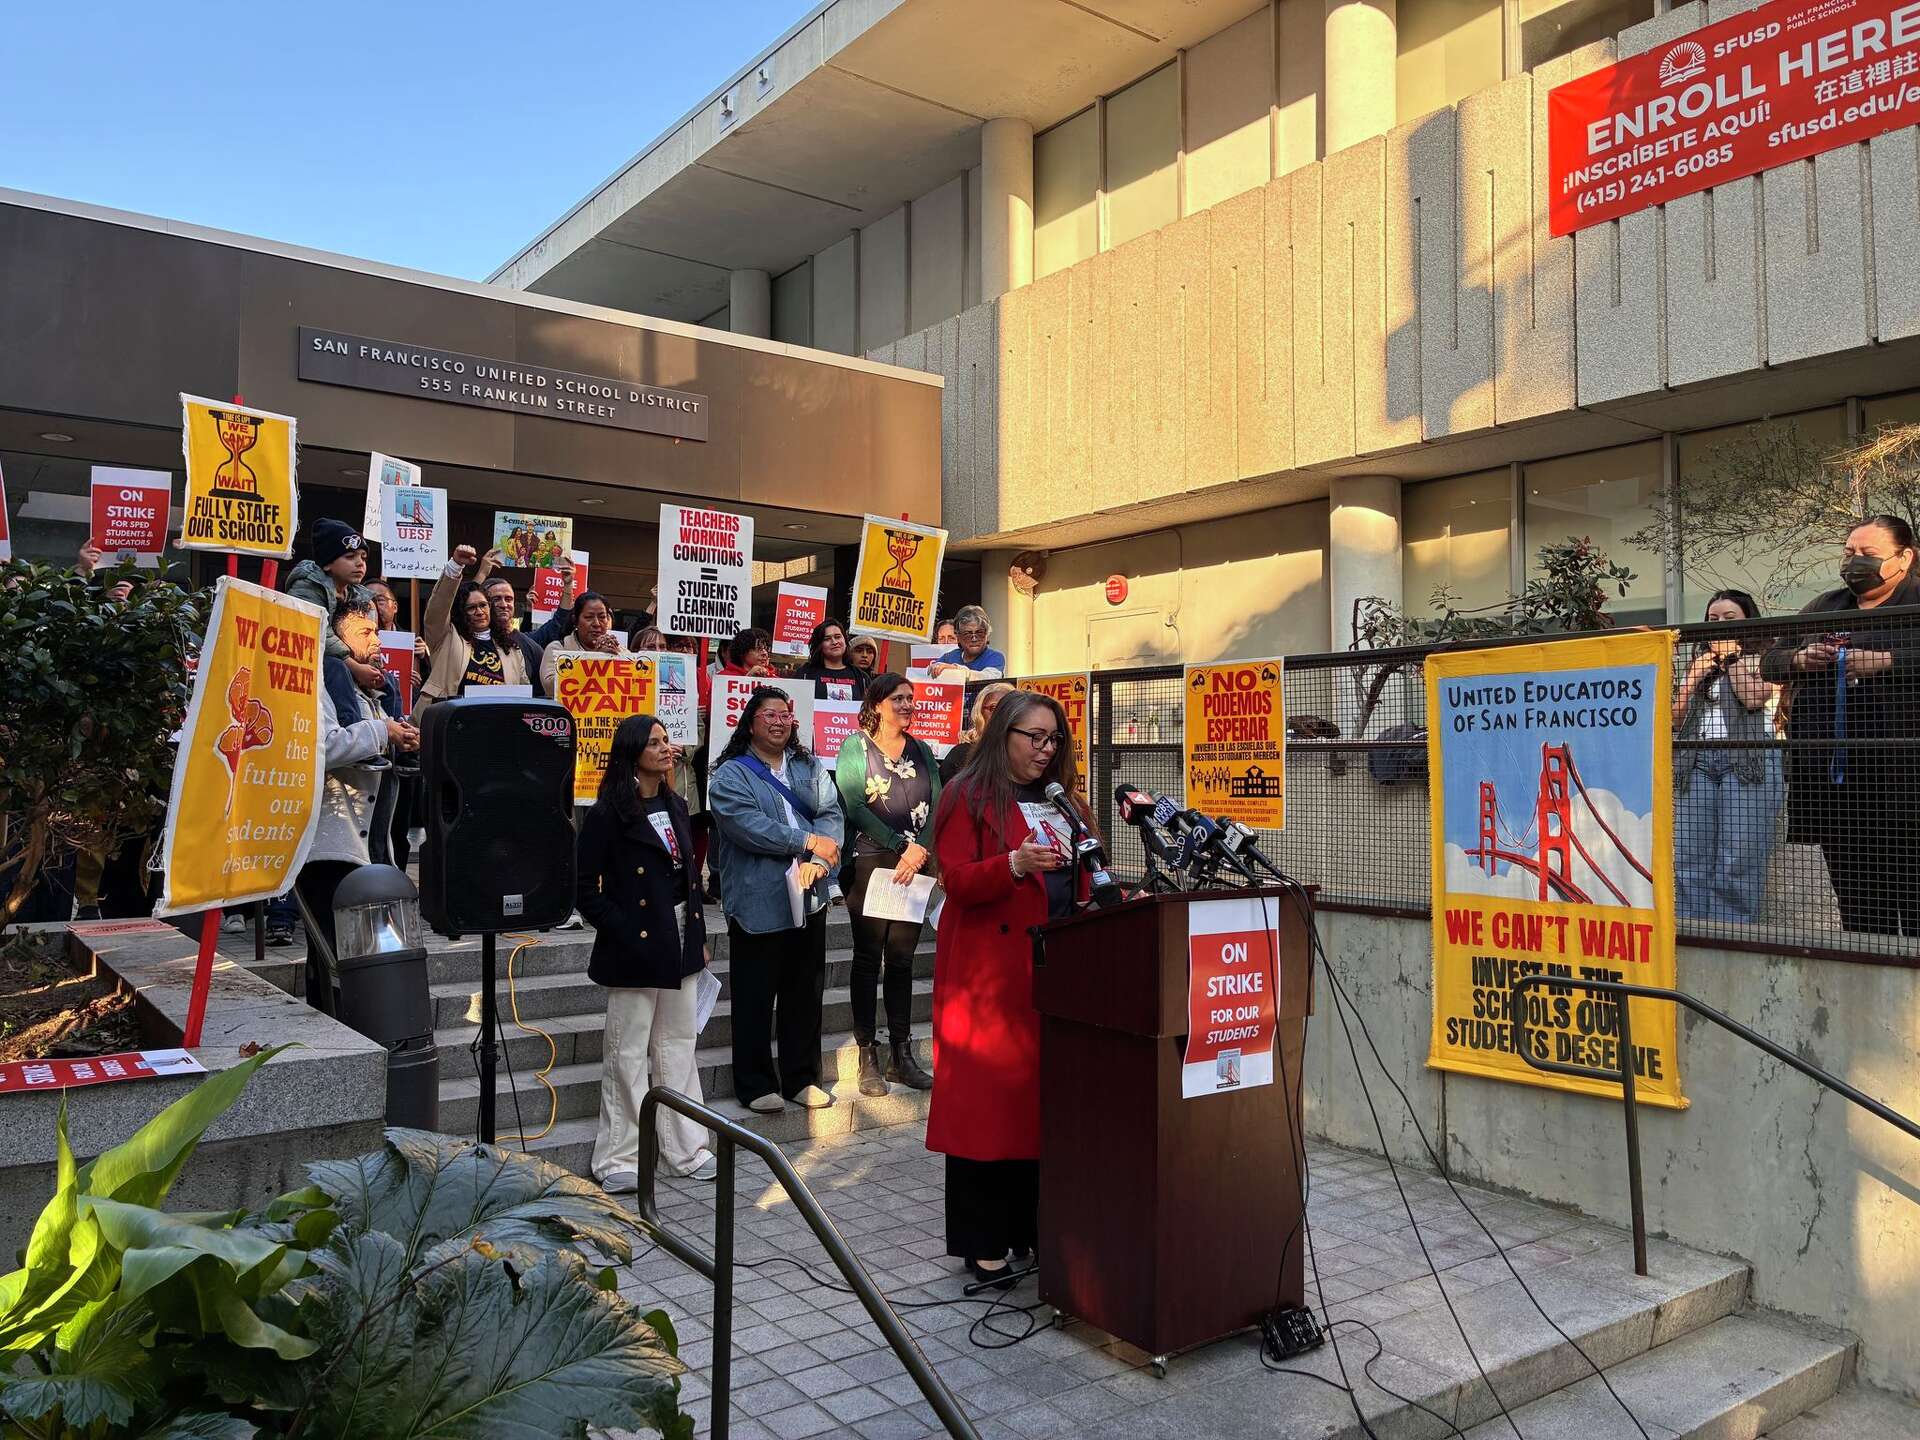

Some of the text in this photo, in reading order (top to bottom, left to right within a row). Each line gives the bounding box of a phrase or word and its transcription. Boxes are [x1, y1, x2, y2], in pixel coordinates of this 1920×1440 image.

[1786, 0, 1844, 24] SAN FRANC
[1786, 0, 1857, 32] PUBLIC SCHOOLS
[1713, 22, 1781, 59] SFUSD
[1587, 2, 1920, 156] ENROLL HERE
[1563, 100, 1771, 194] ¡INSCRÍBETE AQUÍ!
[1576, 143, 1734, 213] (415) 241-6085
[313, 338, 701, 415] SAN FRANCISCO UNIFIED SCHOOL DISTRICT
[420, 376, 616, 419] 555 FRANKLIN STREET
[227, 421, 249, 433] WE
[217, 474, 254, 491] WAIT
[119, 489, 144, 502] ON
[106, 505, 156, 520] STRIKE
[194, 496, 280, 524] FULLY STAFF
[679, 509, 740, 532] TEACHERS
[105, 528, 146, 537] STUDENTS
[111, 519, 150, 529] FOR SPED
[187, 516, 284, 545] OUR SCHOOLS
[397, 527, 433, 540] UESF
[104, 538, 151, 546] EDUCATORS
[679, 526, 736, 549] WORKING
[895, 536, 912, 547] WE
[673, 544, 744, 568] CONDITIONS
[545, 576, 578, 589] STRE
[545, 589, 560, 597] FOR
[678, 580, 738, 601] STUDENTS
[885, 577, 911, 590] WAIT
[677, 597, 735, 619] LEARNING
[794, 598, 809, 608] ON
[862, 592, 925, 616] FULLY STAFF
[670, 614, 741, 636] CONDITIONS
[785, 608, 817, 621] STRIKE
[858, 606, 925, 631] OUR SCHOOLS
[783, 624, 810, 633] STUDENTS
[267, 660, 314, 696] WAIT
[580, 659, 633, 678] WE
[925, 686, 943, 697] ON
[1036, 682, 1072, 700] WE
[1211, 669, 1258, 693] NO
[561, 694, 646, 714] WAIT
[1203, 690, 1273, 717] PODEMOS
[1448, 679, 1643, 708] UNITED EDUCATORS
[914, 700, 953, 712] STRIKE
[292, 710, 312, 735] for
[530, 717, 568, 733] 800
[584, 716, 593, 727] IN
[595, 716, 611, 728] THE
[831, 715, 849, 725] ON
[913, 720, 945, 729] STUDENTS
[1206, 715, 1270, 743] ESPERAR
[1453, 706, 1638, 733] OF SAN FRANCISCO
[577, 727, 613, 739] TUDENTS
[912, 729, 950, 738] EDUCATORS
[286, 740, 309, 761] the
[1218, 743, 1225, 751] EN
[1226, 742, 1236, 751] LAS
[1236, 741, 1264, 751] ESCUELAS
[1265, 741, 1277, 750] QUE
[1218, 751, 1252, 761] ESTUDIANTES
[1252, 750, 1281, 760] MERECEN
[242, 762, 307, 788] future
[270, 796, 304, 816] our
[1445, 908, 1654, 964] WE CAN'T WAIT
[1221, 942, 1249, 964] ON
[1206, 972, 1264, 998] STRIKE
[1472, 956, 1624, 1003] INVEST IN THE
[1210, 1005, 1260, 1025] FOR OUR
[1472, 988, 1621, 1039] SCHOOLS OUR
[1205, 1024, 1261, 1045] STUDENTS
